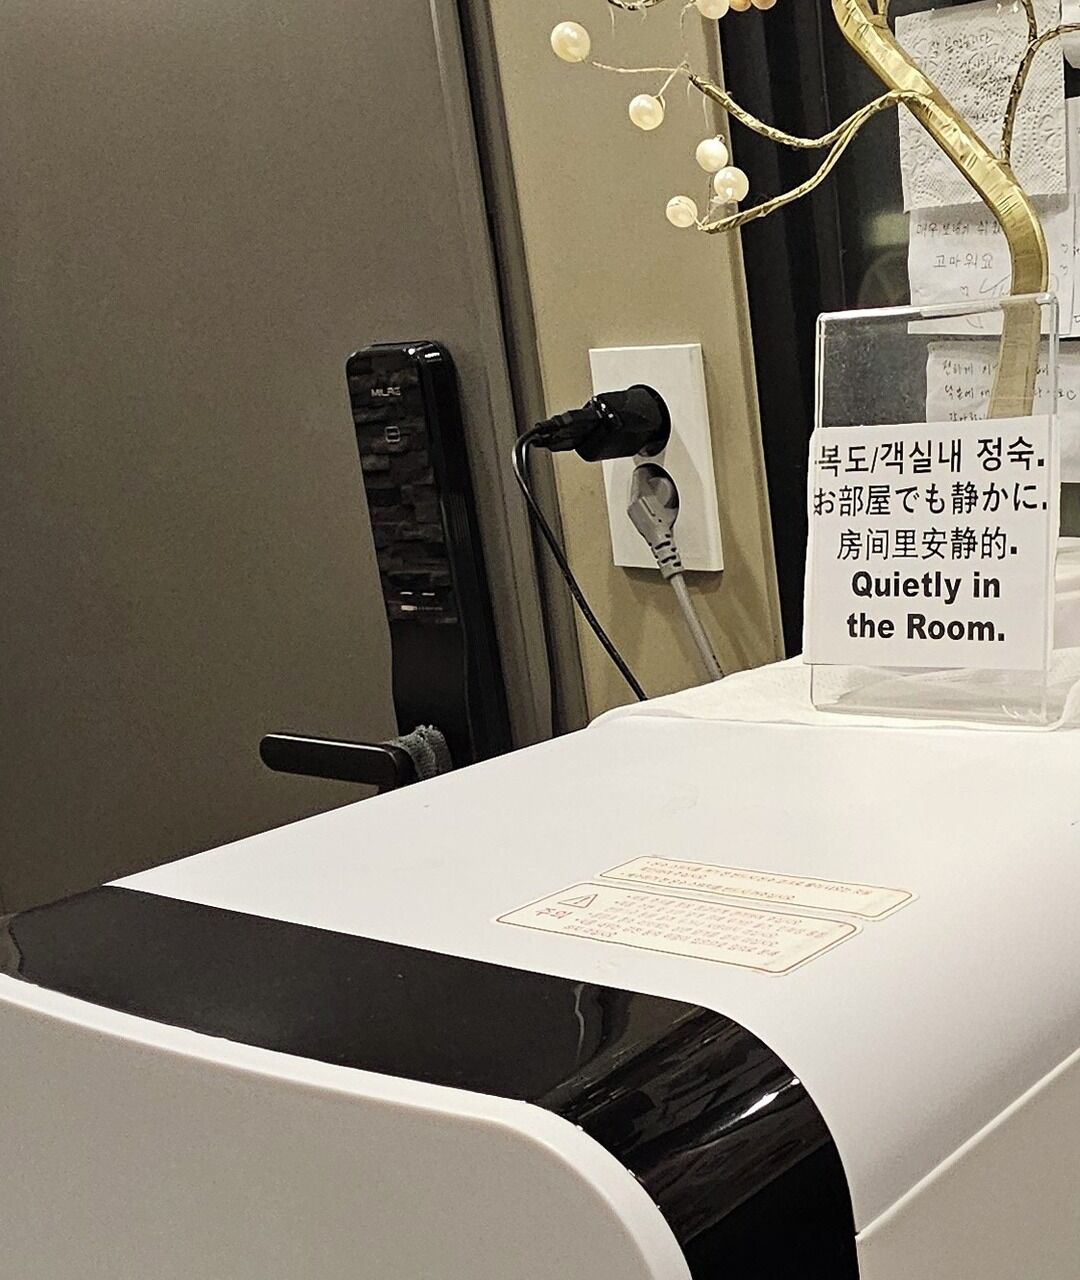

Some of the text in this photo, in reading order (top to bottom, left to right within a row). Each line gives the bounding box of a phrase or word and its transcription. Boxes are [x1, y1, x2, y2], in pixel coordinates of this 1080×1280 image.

[814, 436, 1045, 477] 복도/객실내 정숙.
[837, 526, 1018, 561] 房间里安静的.
[851, 571, 1001, 605] Quietly in
[846, 612, 1005, 642] the Room.
